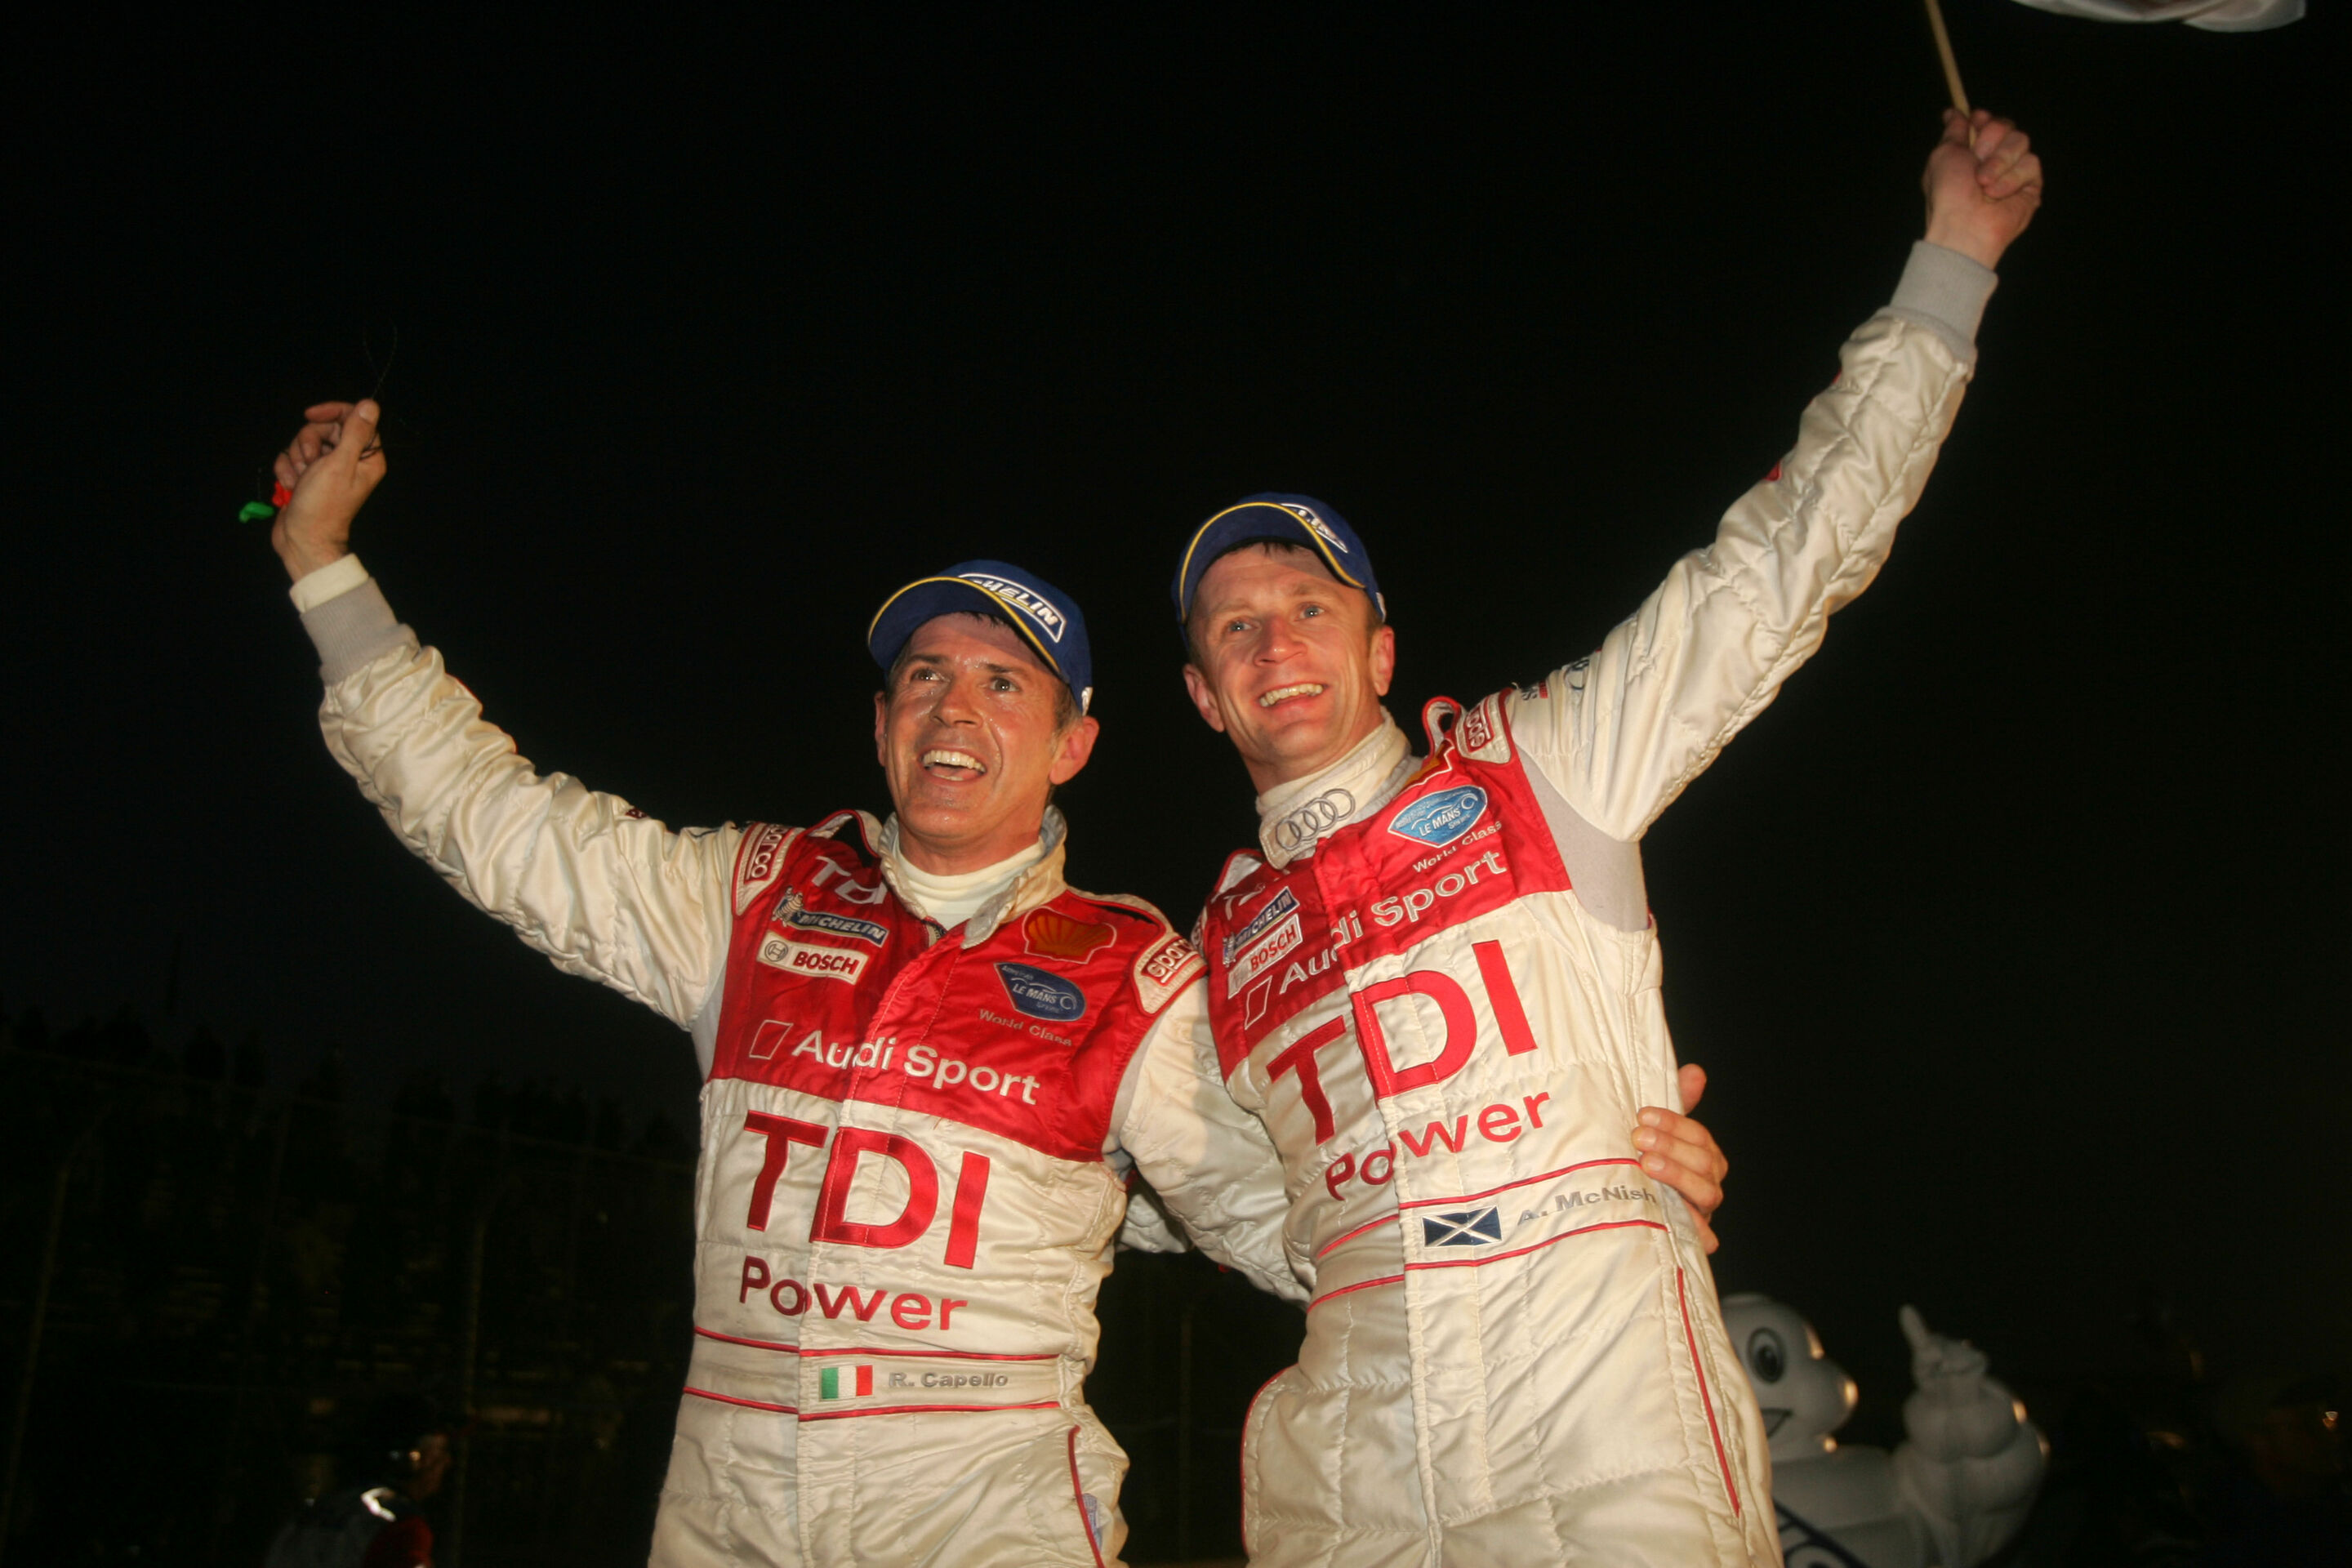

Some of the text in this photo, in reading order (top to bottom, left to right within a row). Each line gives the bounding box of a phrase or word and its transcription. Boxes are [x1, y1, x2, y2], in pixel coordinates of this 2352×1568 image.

[972, 580, 1058, 626] HELIN
[1413, 821, 1502, 872] World Class
[1419, 823, 1432, 836] LE
[1432, 808, 1461, 830] MANS
[798, 913, 887, 939] MICHELIN
[1236, 892, 1293, 945] MICHELIN
[1279, 910, 1363, 995] Audi
[1371, 850, 1507, 927] Sport
[792, 951, 859, 975] BOSCH
[1250, 924, 1297, 973] BOSCH
[1013, 983, 1058, 1004] LE MANS
[979, 1009, 1072, 1046] World Class
[1266, 939, 1538, 1147] TDI
[791, 1030, 1040, 1106] Audi Sport
[1325, 1091, 1550, 1201] Power
[744, 1110, 991, 1270] TDI
[1517, 1185, 1657, 1225] A. McNish
[739, 1255, 968, 1331] Power
[889, 1371, 1009, 1388] R. Capello
